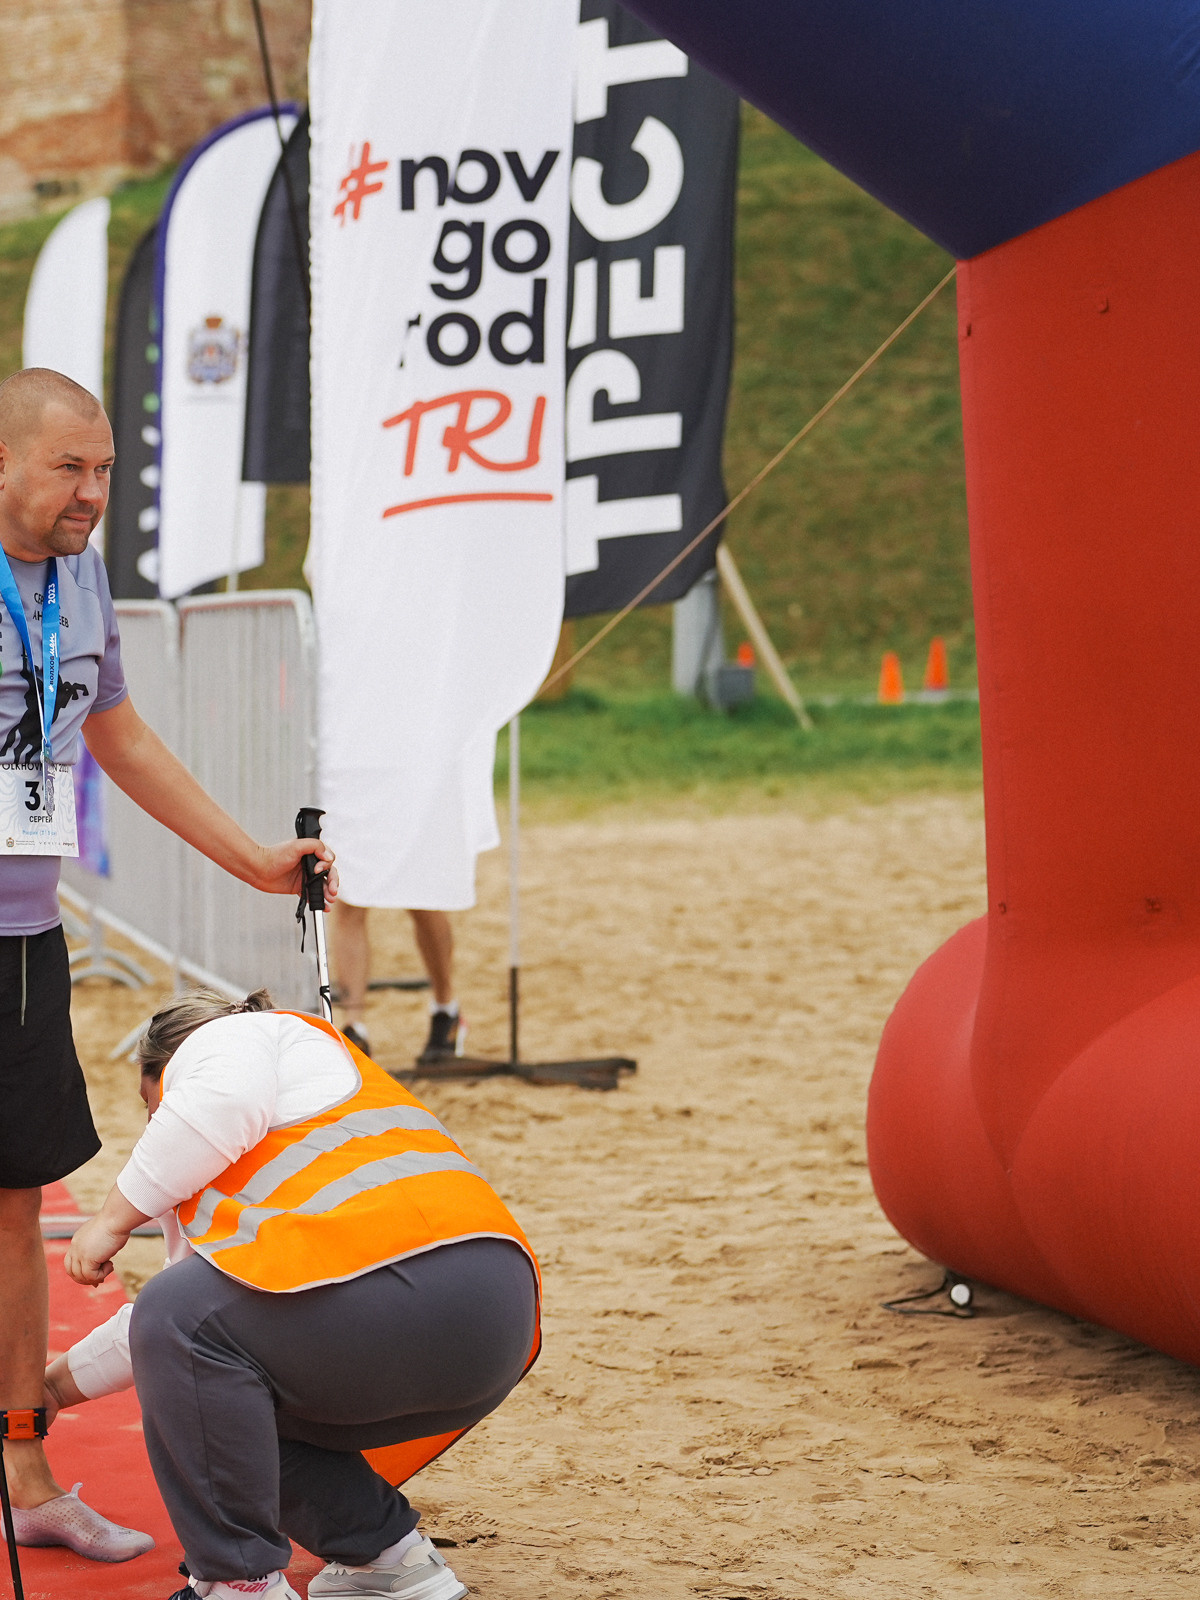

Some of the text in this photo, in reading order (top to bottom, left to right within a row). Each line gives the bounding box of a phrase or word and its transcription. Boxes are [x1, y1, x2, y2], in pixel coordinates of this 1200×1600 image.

[429, 219, 551, 301] go
[381, 389, 547, 477] TRI
[48, 583, 56, 604] 2023
[29, 815, 53, 823] СЕРГЕЙ
